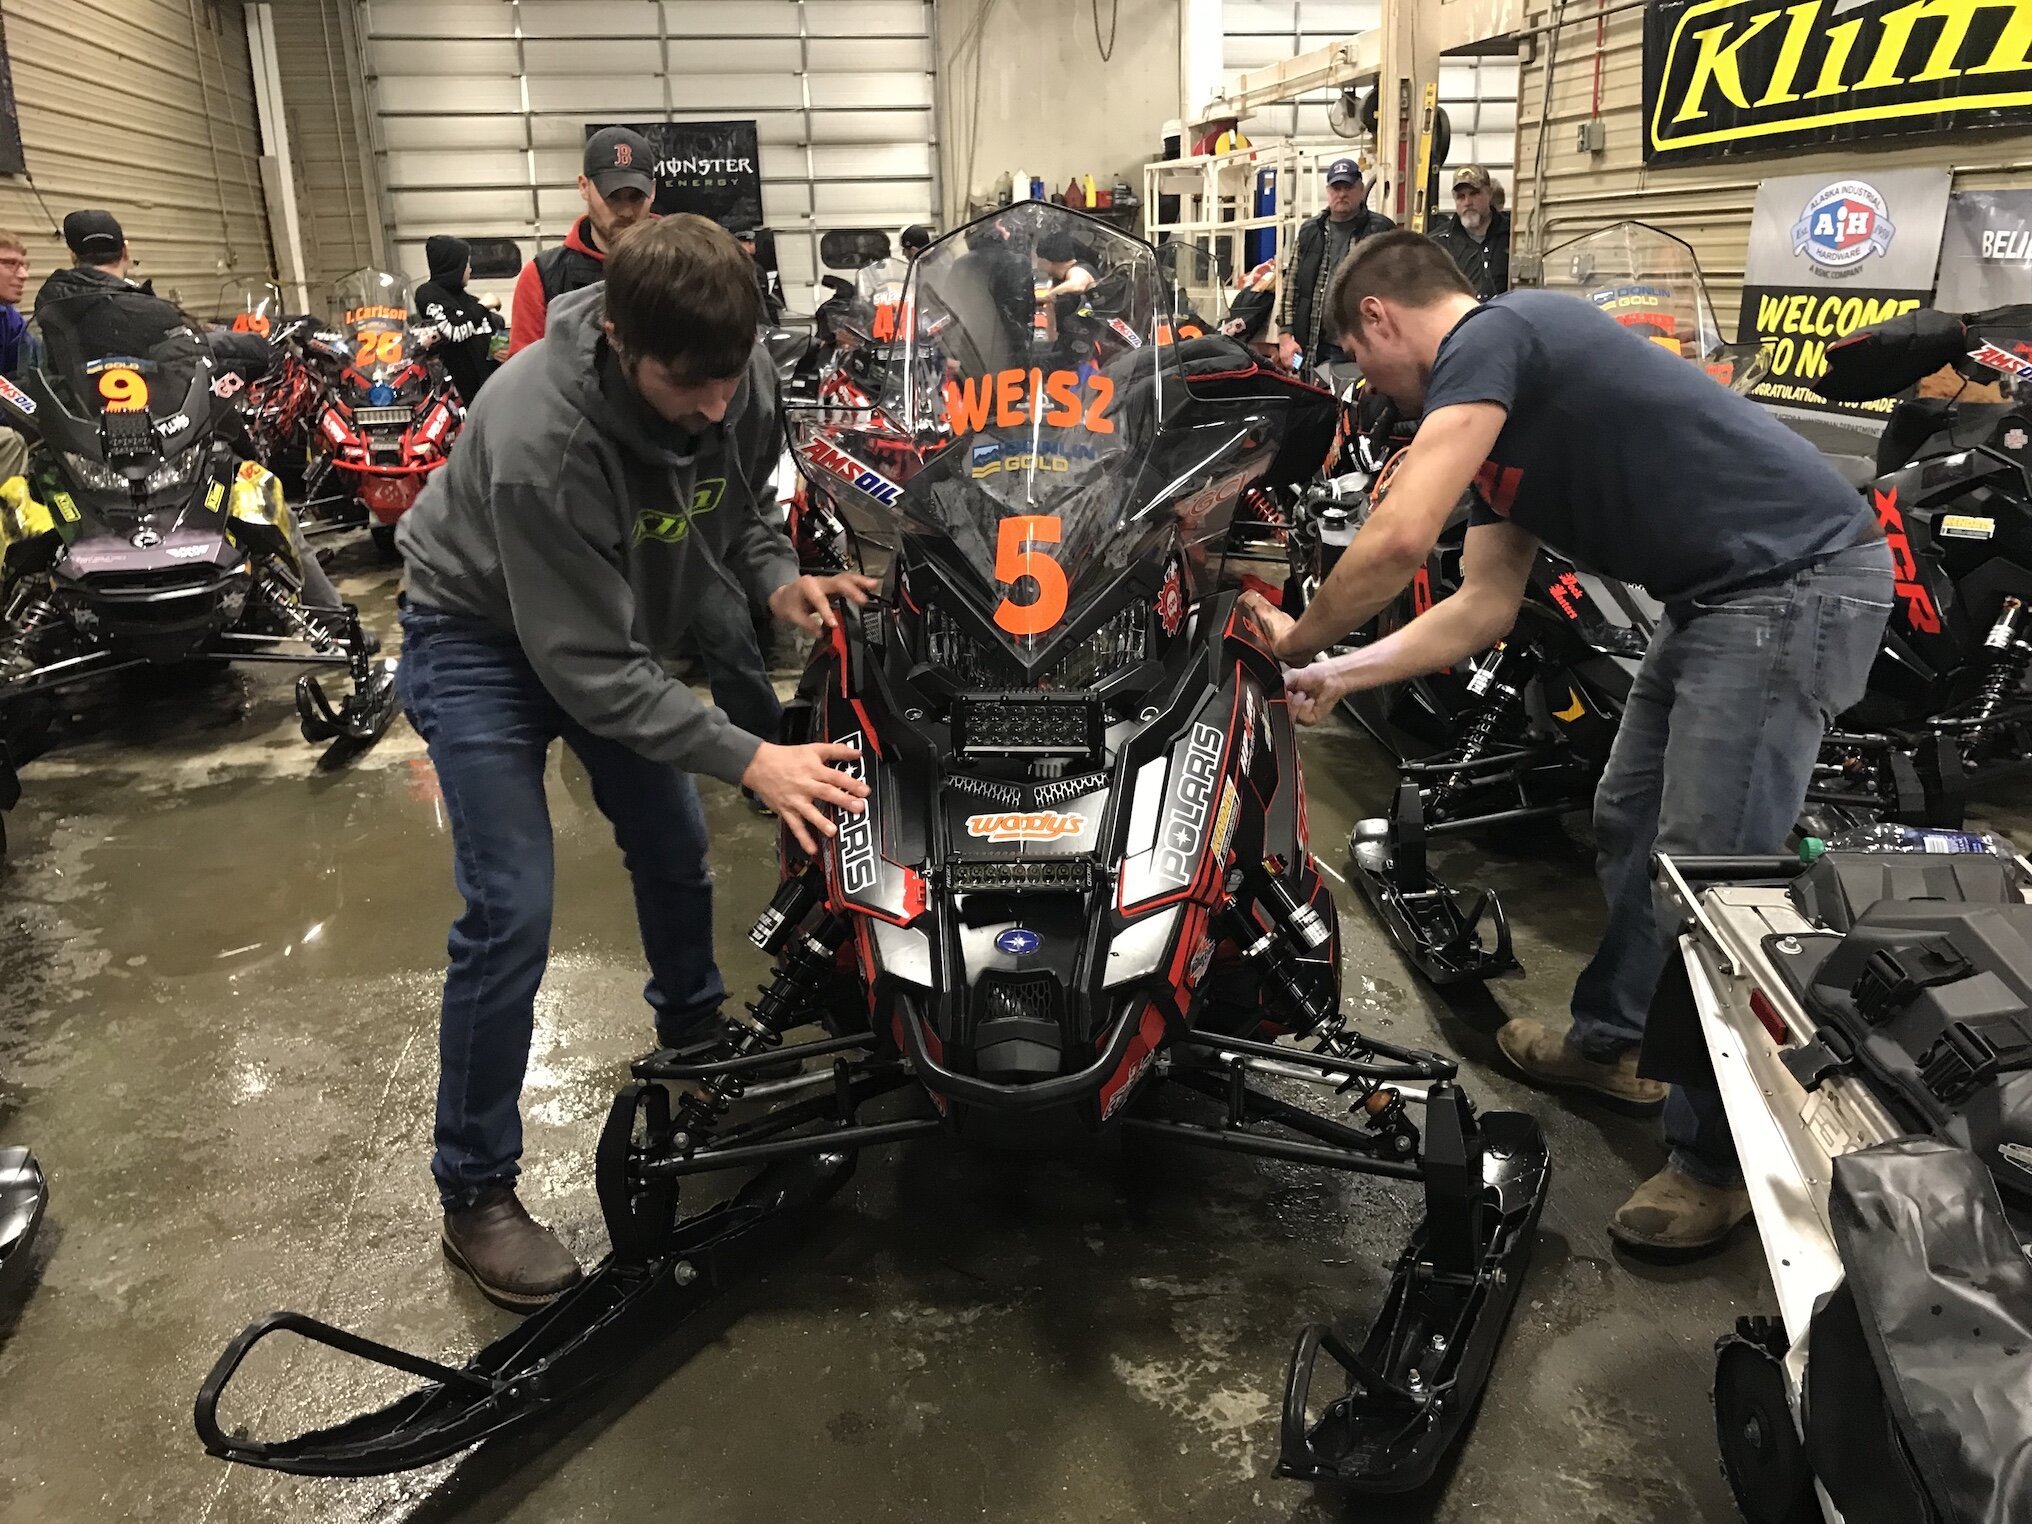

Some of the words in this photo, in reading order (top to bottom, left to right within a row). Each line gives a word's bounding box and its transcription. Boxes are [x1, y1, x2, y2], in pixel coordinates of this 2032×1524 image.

[1671, 0, 2032, 124] Klim
[614, 144, 632, 168] B
[665, 178, 739, 187] ENERGY
[1811, 188, 1840, 211] ALASKA
[1841, 186, 1881, 211] INDUSTRIAL
[1816, 247, 1861, 261] HARDWARE
[1619, 296, 1658, 307] GOLD
[1112, 318, 1142, 347] AMSOIL
[99, 368, 149, 414] 9
[948, 367, 1115, 436] WEISZ
[800, 437, 898, 506] AMSOIL
[1004, 454, 1070, 472] GOLD
[992, 515, 1069, 635] 5
[1160, 721, 1225, 886] POLARIS
